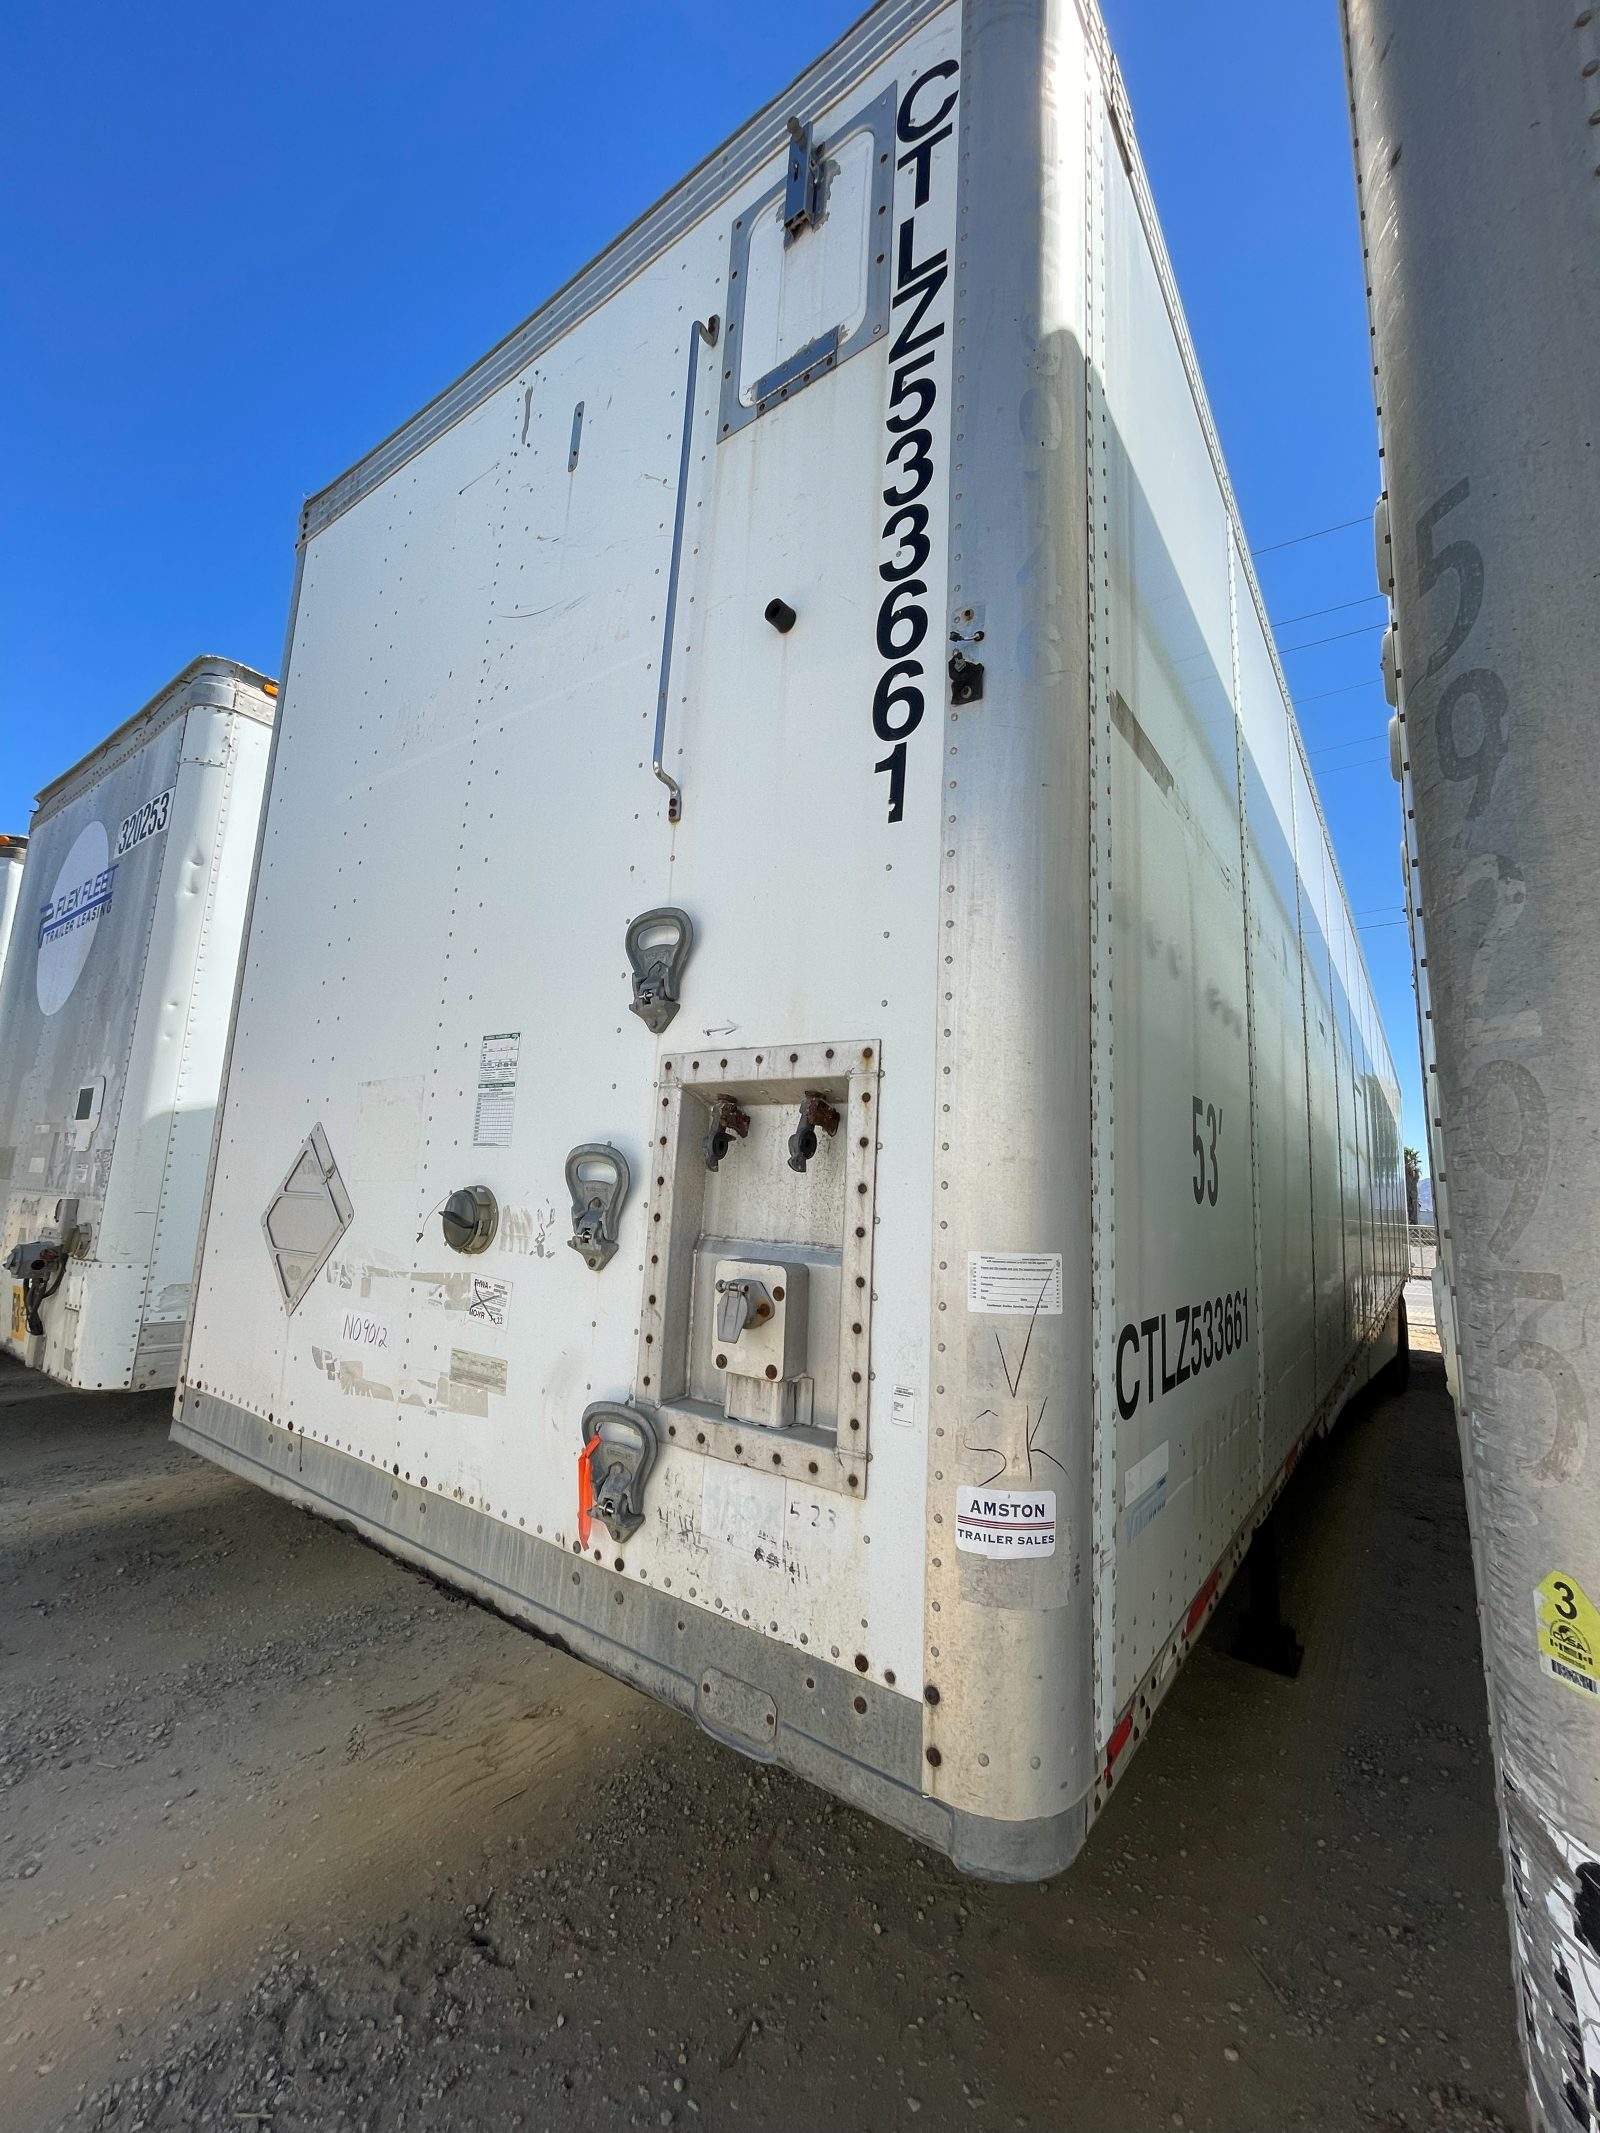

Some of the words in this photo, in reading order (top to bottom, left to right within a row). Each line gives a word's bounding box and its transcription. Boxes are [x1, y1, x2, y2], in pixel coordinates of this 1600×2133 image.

[872, 59, 961, 824] CTLZ533661
[118, 792, 170, 855] 320253
[55, 886, 82, 919] FLEX
[82, 864, 119, 905] FLEET
[46, 921, 74, 945] TRAILER
[77, 899, 113, 929] LEASING
[1116, 1288, 1250, 1422] CTLZ533661
[970, 1499, 1046, 1518] AMSTON
[957, 1528, 1013, 1545] TRAILER
[1017, 1533, 1055, 1545] SALES
[1553, 1581, 1578, 1620] 3
